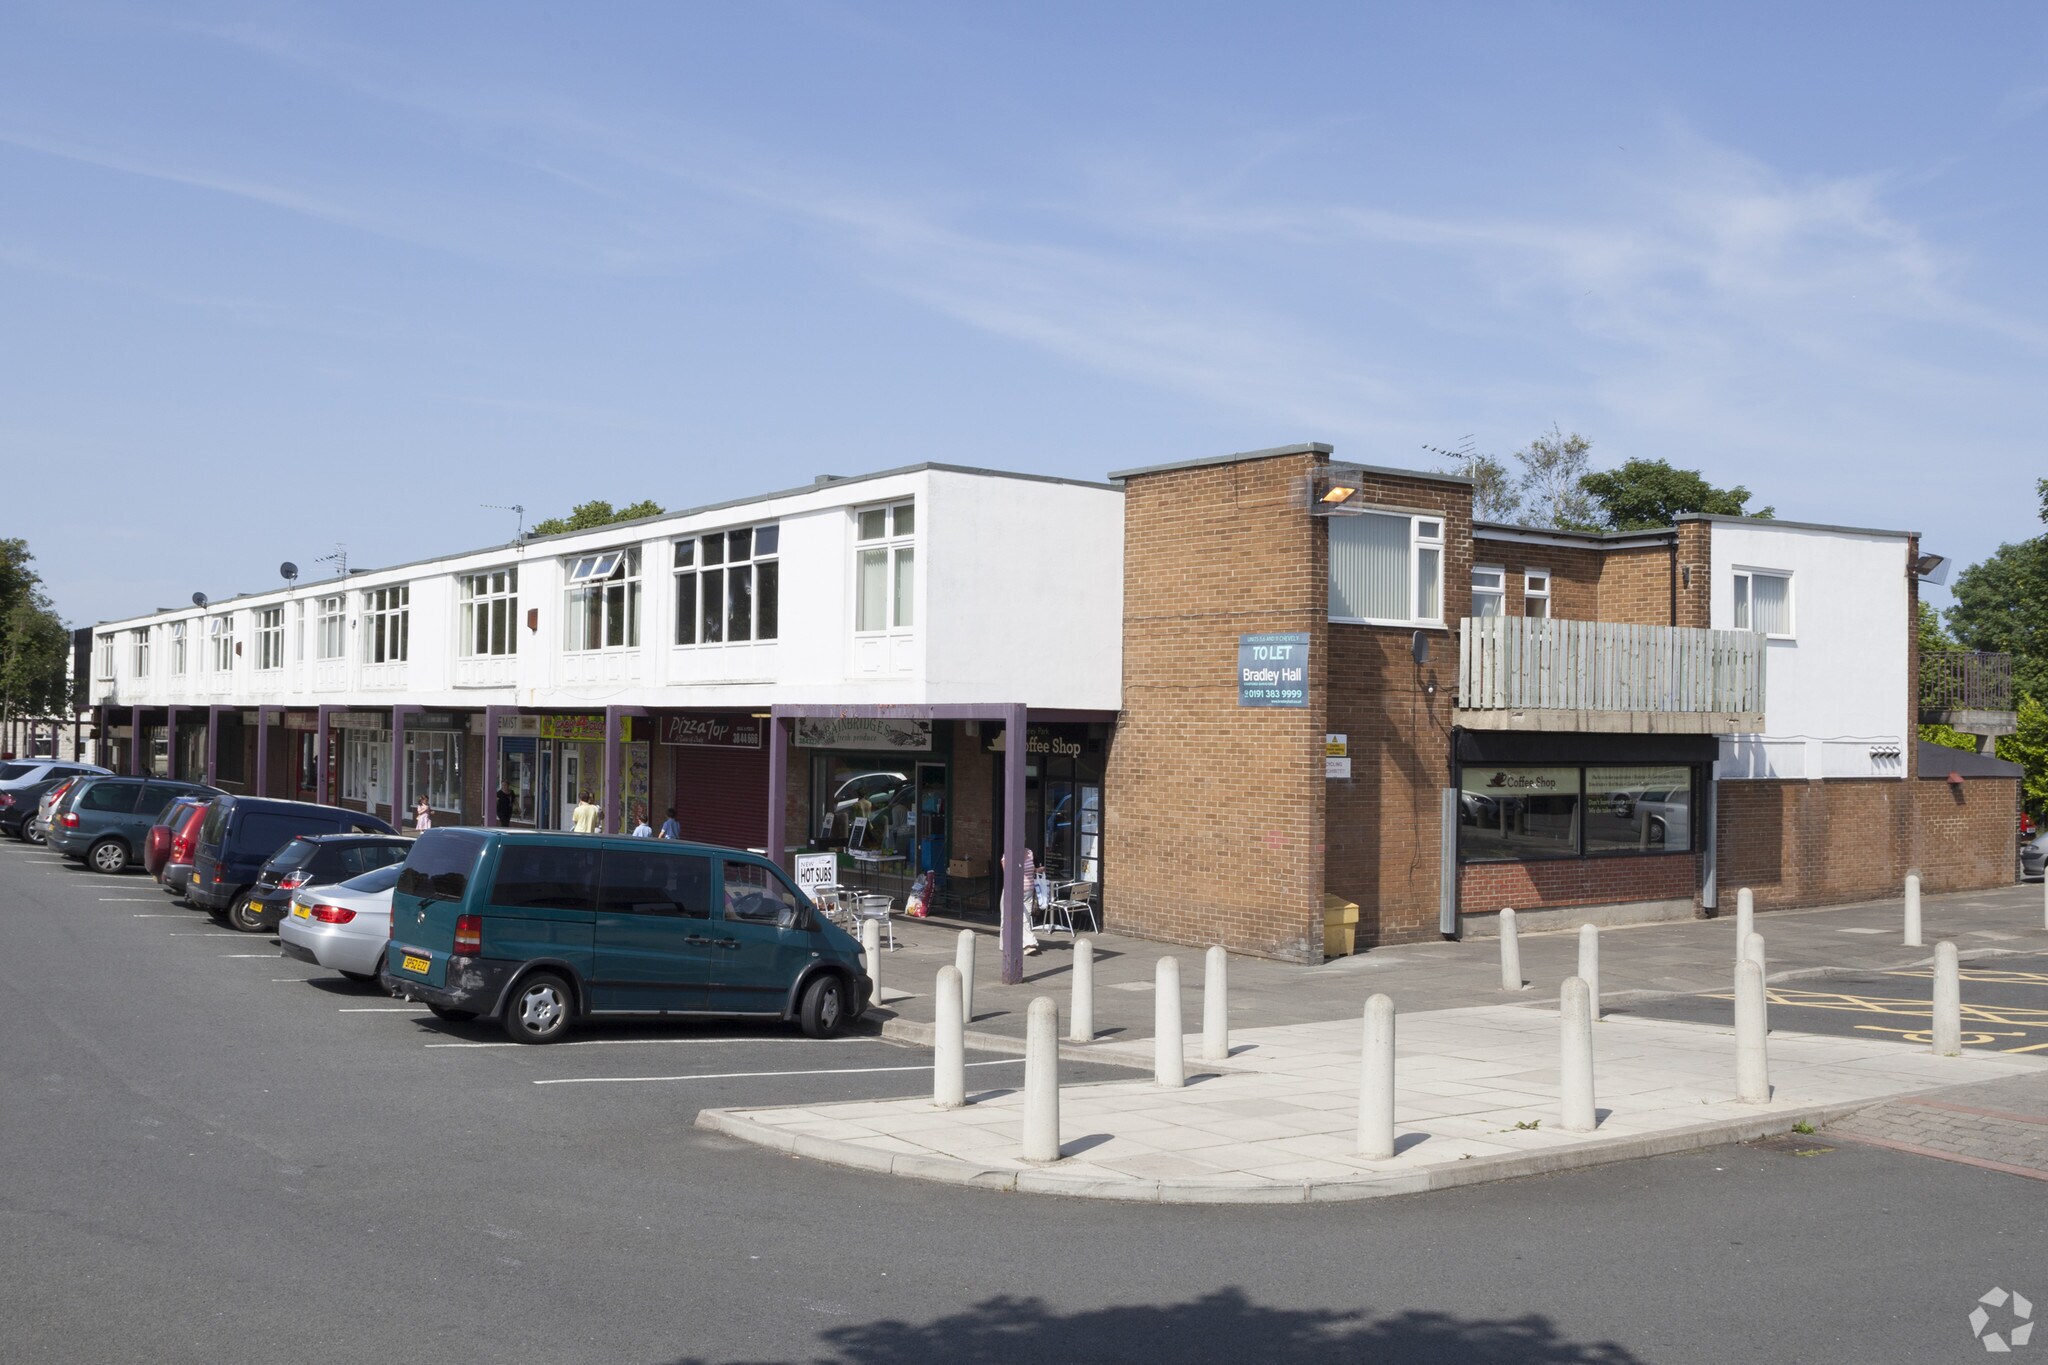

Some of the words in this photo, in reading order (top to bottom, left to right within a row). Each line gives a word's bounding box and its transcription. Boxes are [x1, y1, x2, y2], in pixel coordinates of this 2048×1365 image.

[1253, 646, 1268, 660] TO
[1270, 645, 1292, 660] LET
[1243, 667, 1280, 686] Bradley
[1282, 667, 1302, 681] Hall
[1249, 689, 1264, 698] 0191
[1265, 689, 1280, 698] 383
[1281, 689, 1302, 698] 9999
[498, 716, 518, 728] EMIST
[707, 720, 729, 740] Top
[824, 717, 892, 738] BAINBRIDGES
[1025, 736, 1050, 753] offee
[1052, 736, 1081, 758] Shop
[1507, 776, 1534, 788] Coffee
[1535, 775, 1556, 790] Shop
[801, 868, 814, 883] HOT
[816, 867, 831, 882] SUBS
